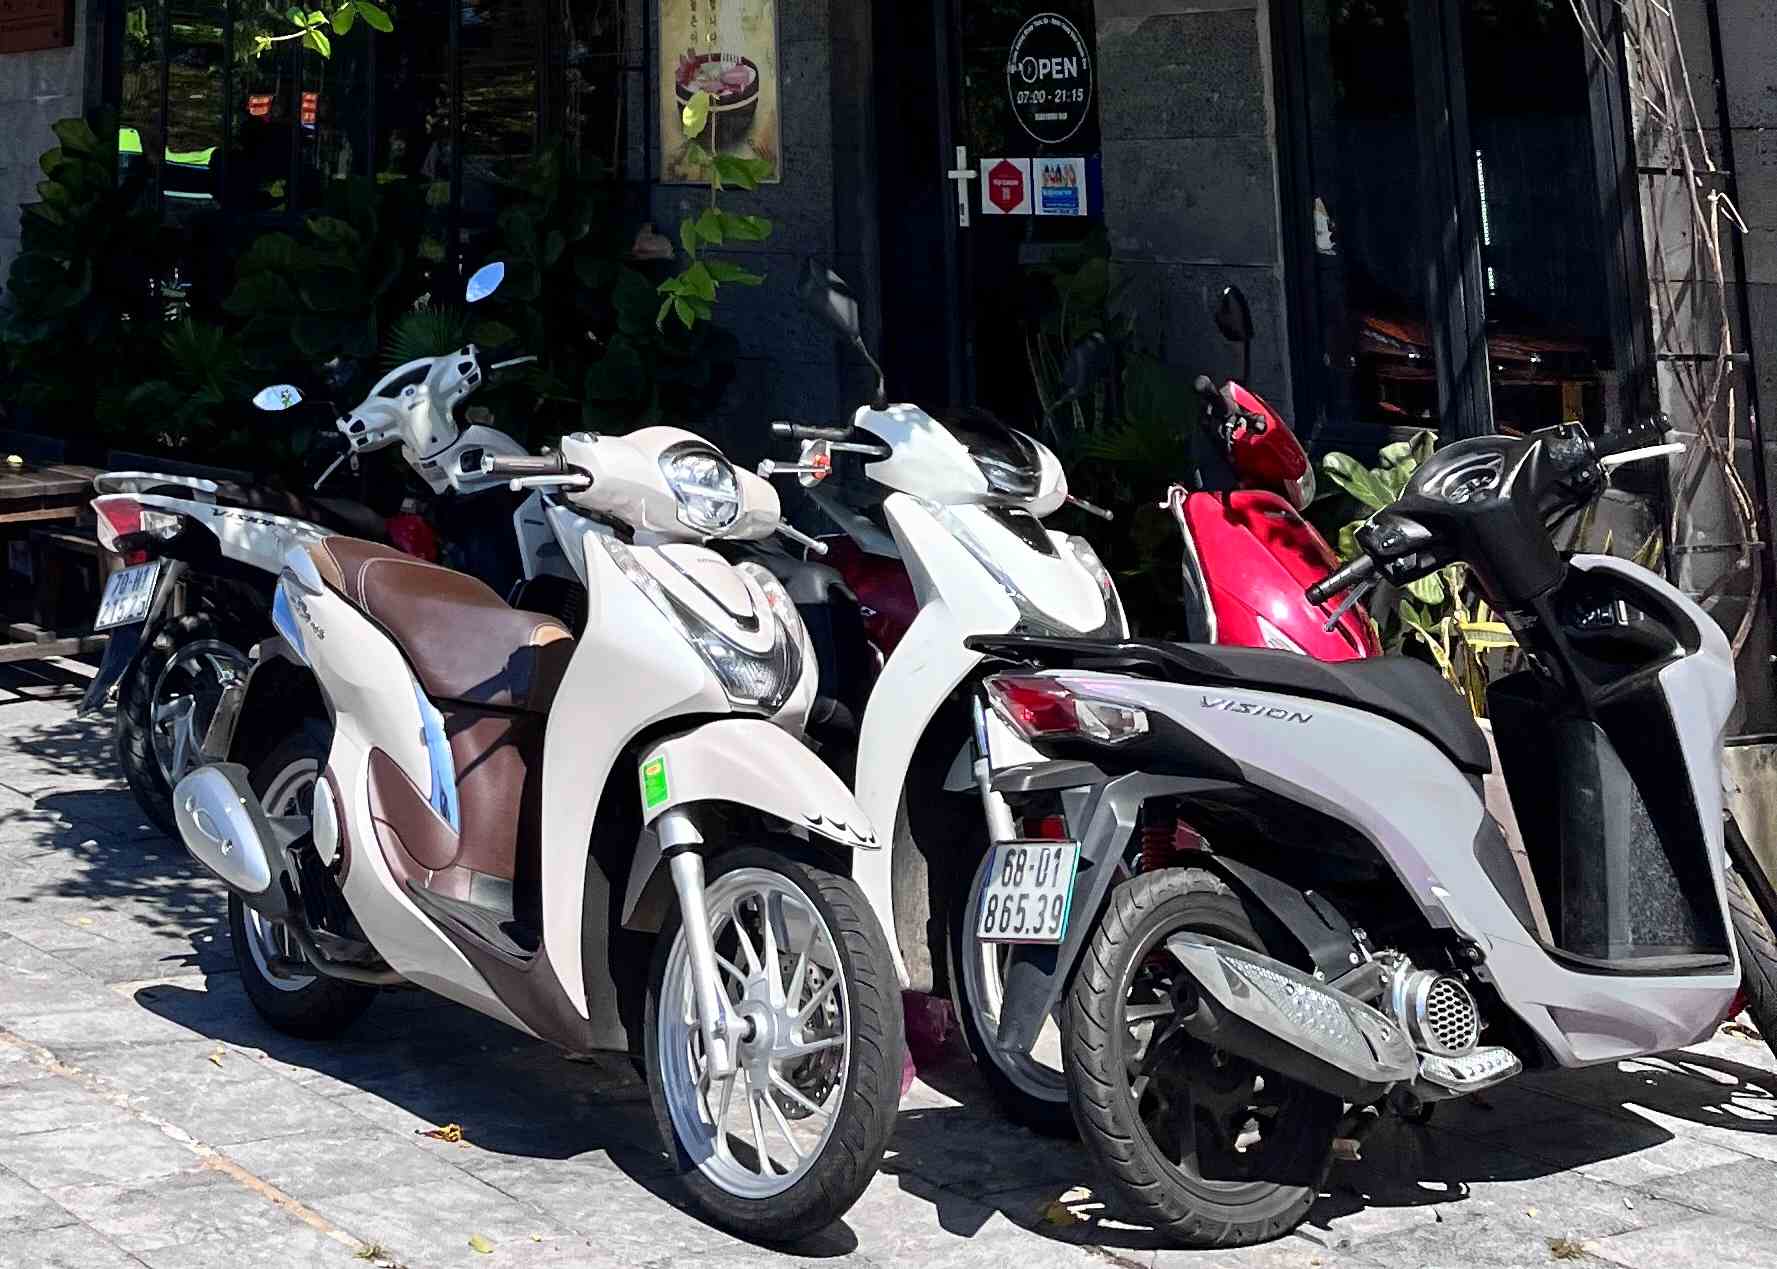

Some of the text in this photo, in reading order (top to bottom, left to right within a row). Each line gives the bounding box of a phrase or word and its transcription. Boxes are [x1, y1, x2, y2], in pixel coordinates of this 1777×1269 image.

[1020, 56, 1078, 83] OPEN
[1054, 88, 1084, 103] 21:15
[1200, 695, 1313, 724] VISION
[984, 894, 1064, 935] 865.39
